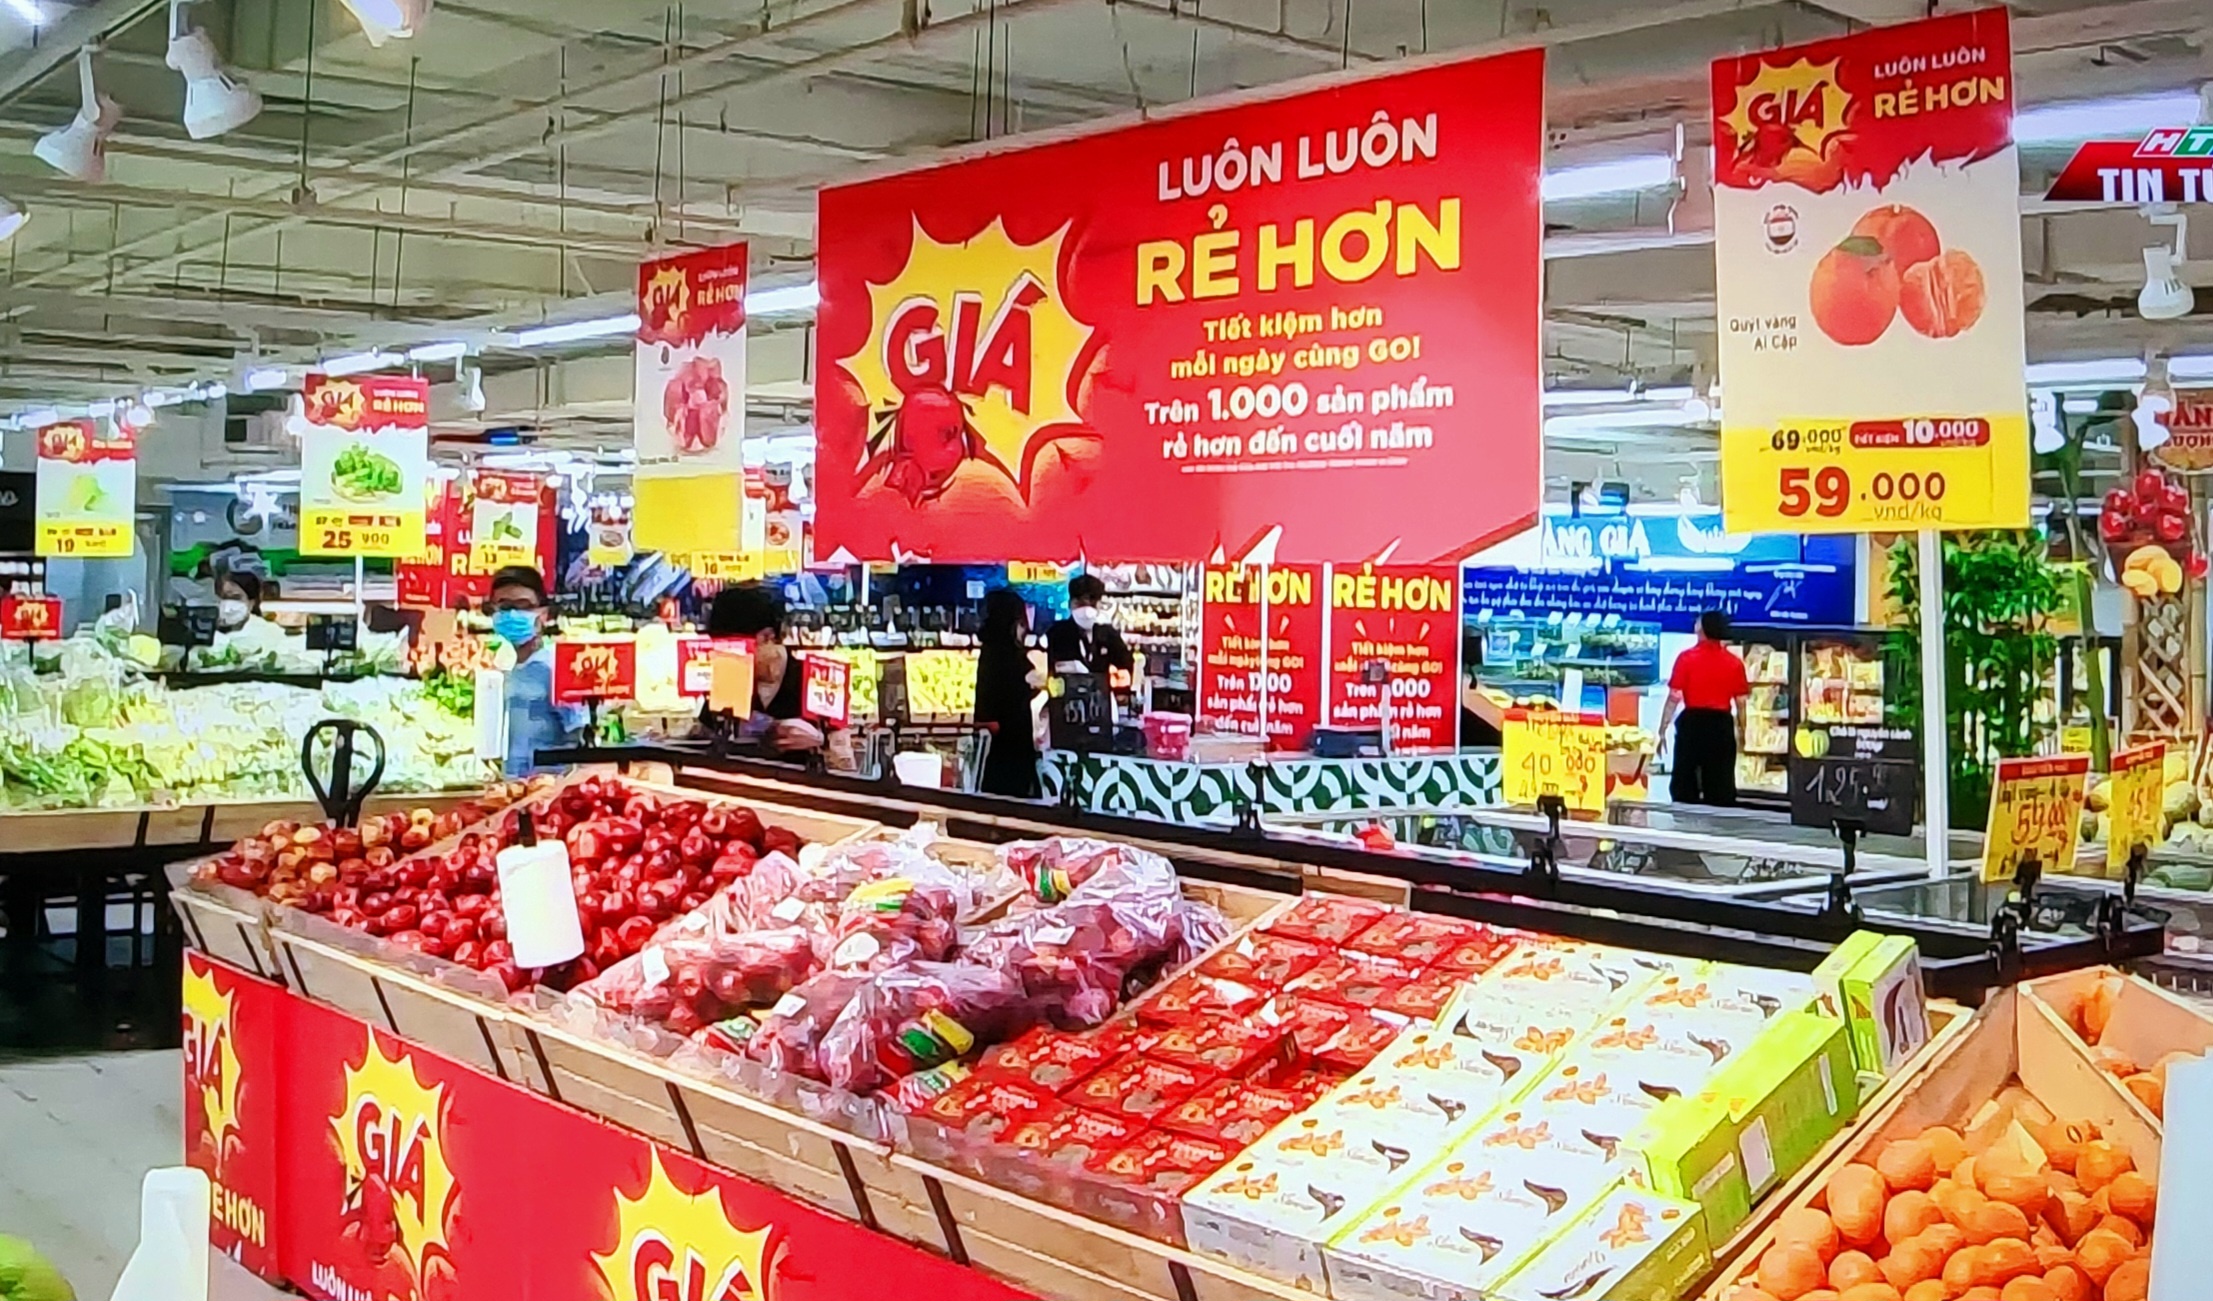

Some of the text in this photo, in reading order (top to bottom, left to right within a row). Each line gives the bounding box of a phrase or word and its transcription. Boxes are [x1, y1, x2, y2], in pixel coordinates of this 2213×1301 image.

[1874, 47, 1985, 79] LUÔN LUÔN
[1874, 76, 2004, 118] RẺ HƠN
[1158, 110, 1438, 201] LUÔN LUÔN
[1136, 198, 1460, 305] RẺ HƠN
[882, 269, 1048, 415] GIÁ
[1331, 306, 1382, 330] hơn
[1223, 349, 1285, 377] ngày
[1207, 382, 1308, 420] 1.000
[1193, 433, 1241, 457] hơn
[1332, 562, 1376, 609] RẺ
[1381, 575, 1452, 612] HƠN
[355, 1092, 432, 1231] GIÁ
[225, 1188, 266, 1248] HƠN
[630, 1226, 754, 1301] GI
